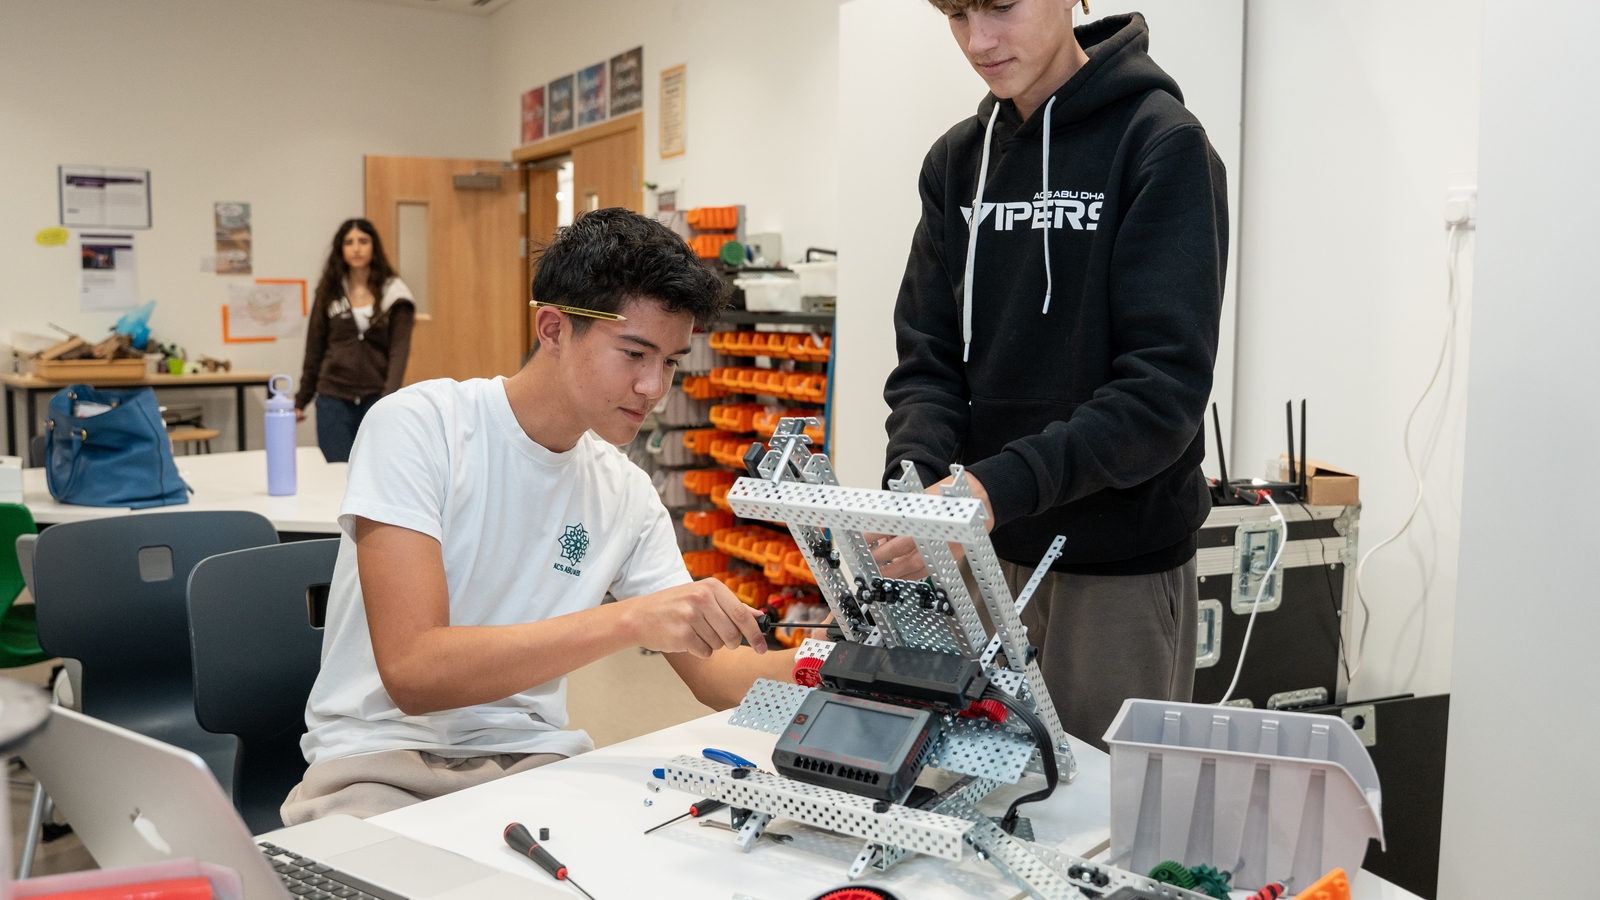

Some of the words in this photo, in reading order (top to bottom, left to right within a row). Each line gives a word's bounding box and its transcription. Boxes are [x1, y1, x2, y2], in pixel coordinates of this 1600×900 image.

[1053, 190, 1079, 199] ABU
[1080, 191, 1105, 200] DHA
[959, 201, 1103, 230] VIPERS
